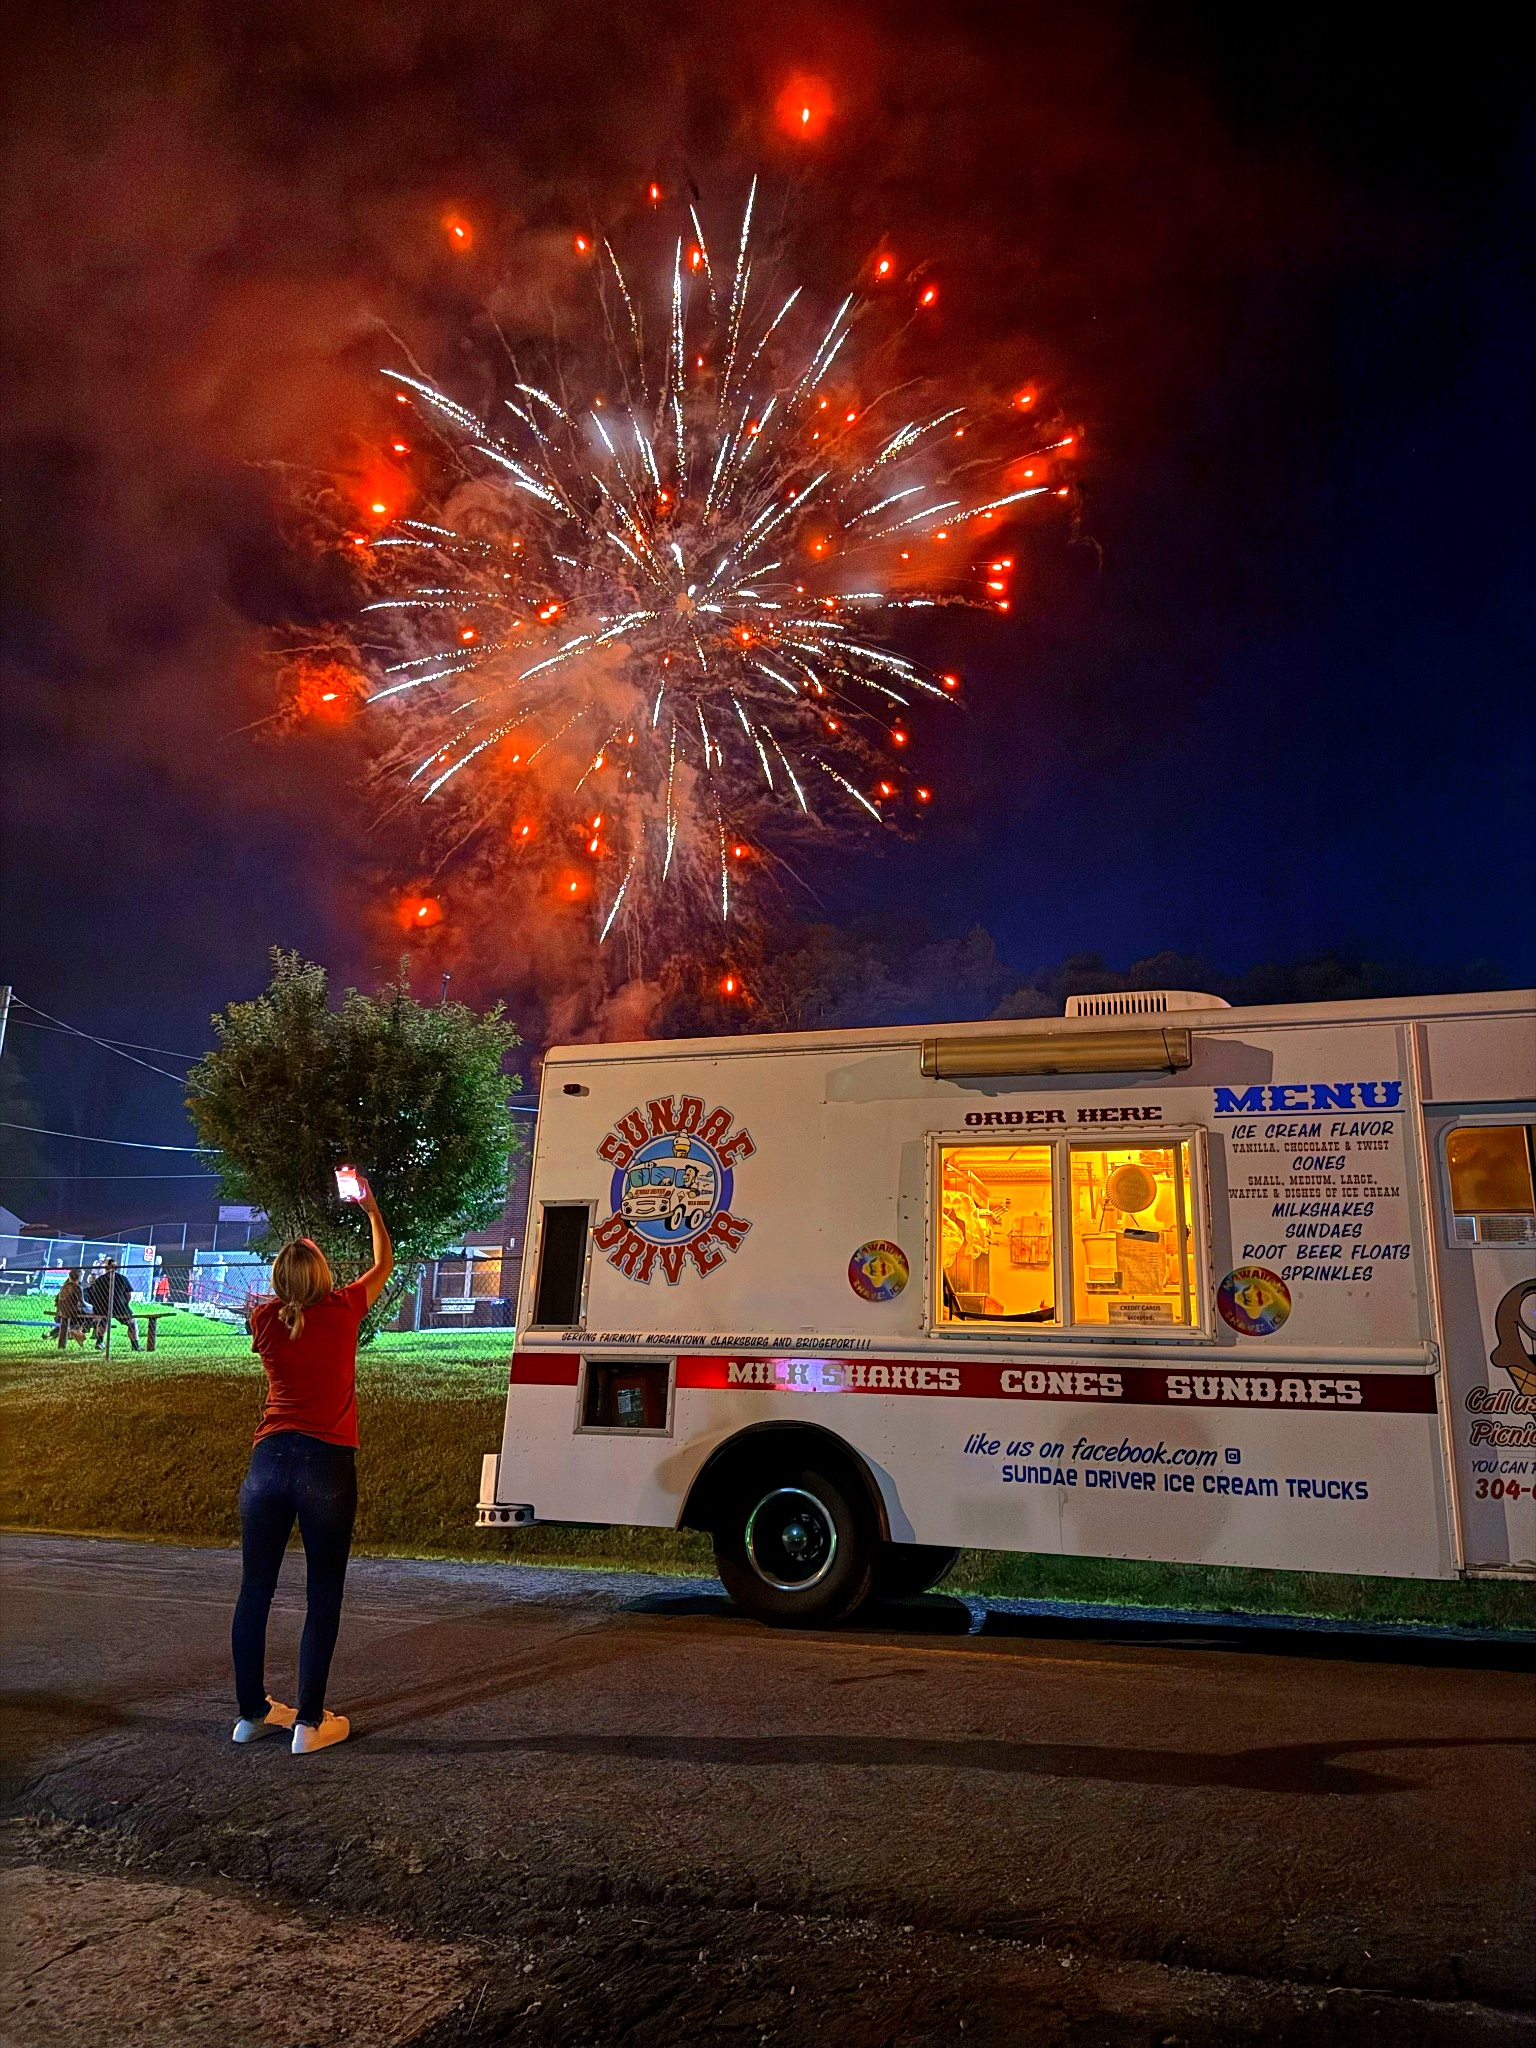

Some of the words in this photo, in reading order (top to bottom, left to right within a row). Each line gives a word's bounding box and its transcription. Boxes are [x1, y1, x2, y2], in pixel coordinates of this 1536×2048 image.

[1213, 1081, 1402, 1112] MENU
[964, 1110, 1066, 1126] ORDER
[1077, 1107, 1162, 1122] HERE
[597, 1095, 756, 1171] SUNDAE
[1231, 1125, 1257, 1139] ICE
[1264, 1123, 1322, 1138] CREAM
[1330, 1121, 1394, 1137] FLAVOR
[1284, 1141, 1340, 1152] CHOCOLATE
[1345, 1142, 1352, 1151] &
[1356, 1140, 1389, 1151] TWIST
[1292, 1155, 1346, 1170] CONES
[1228, 1188, 1269, 1199] WAFFLE
[1273, 1189, 1280, 1198] &
[1284, 1188, 1321, 1198] DISHES
[1325, 1187, 1338, 1198] OF
[1342, 1187, 1359, 1197] ICE
[1363, 1186, 1400, 1197] CREAM
[1271, 1201, 1374, 1217] MILKSHAKES
[1285, 1223, 1363, 1238] SUNDAES
[593, 1210, 753, 1286] DRIVER
[1242, 1245, 1288, 1259] ROOT
[1296, 1245, 1342, 1259] BEER
[1351, 1244, 1411, 1259] FLOATS
[1281, 1265, 1373, 1281] SPRINKLES
[561, 1332, 597, 1342] SERVING
[600, 1333, 643, 1343] FAIRMONT
[646, 1334, 706, 1345] MORGANTOWN
[711, 1336, 769, 1347] CLARKSBURG
[773, 1337, 792, 1347] AND
[795, 1338, 871, 1349] BRIDGEPORT!!!
[727, 1362, 810, 1385] MILK
[821, 1363, 962, 1391] SHAKES
[1000, 1370, 1124, 1396] CONES
[1166, 1375, 1364, 1404] SUNDAES
[1465, 1386, 1514, 1414] Call
[963, 1433, 1001, 1455] like
[1006, 1440, 1034, 1457] us
[1039, 1441, 1064, 1459] on
[1071, 1437, 1217, 1467] facebook.com
[1472, 1460, 1499, 1473] YOU
[1500, 1461, 1528, 1474] CAN
[1285, 1479, 1369, 1501] TRUCKS
